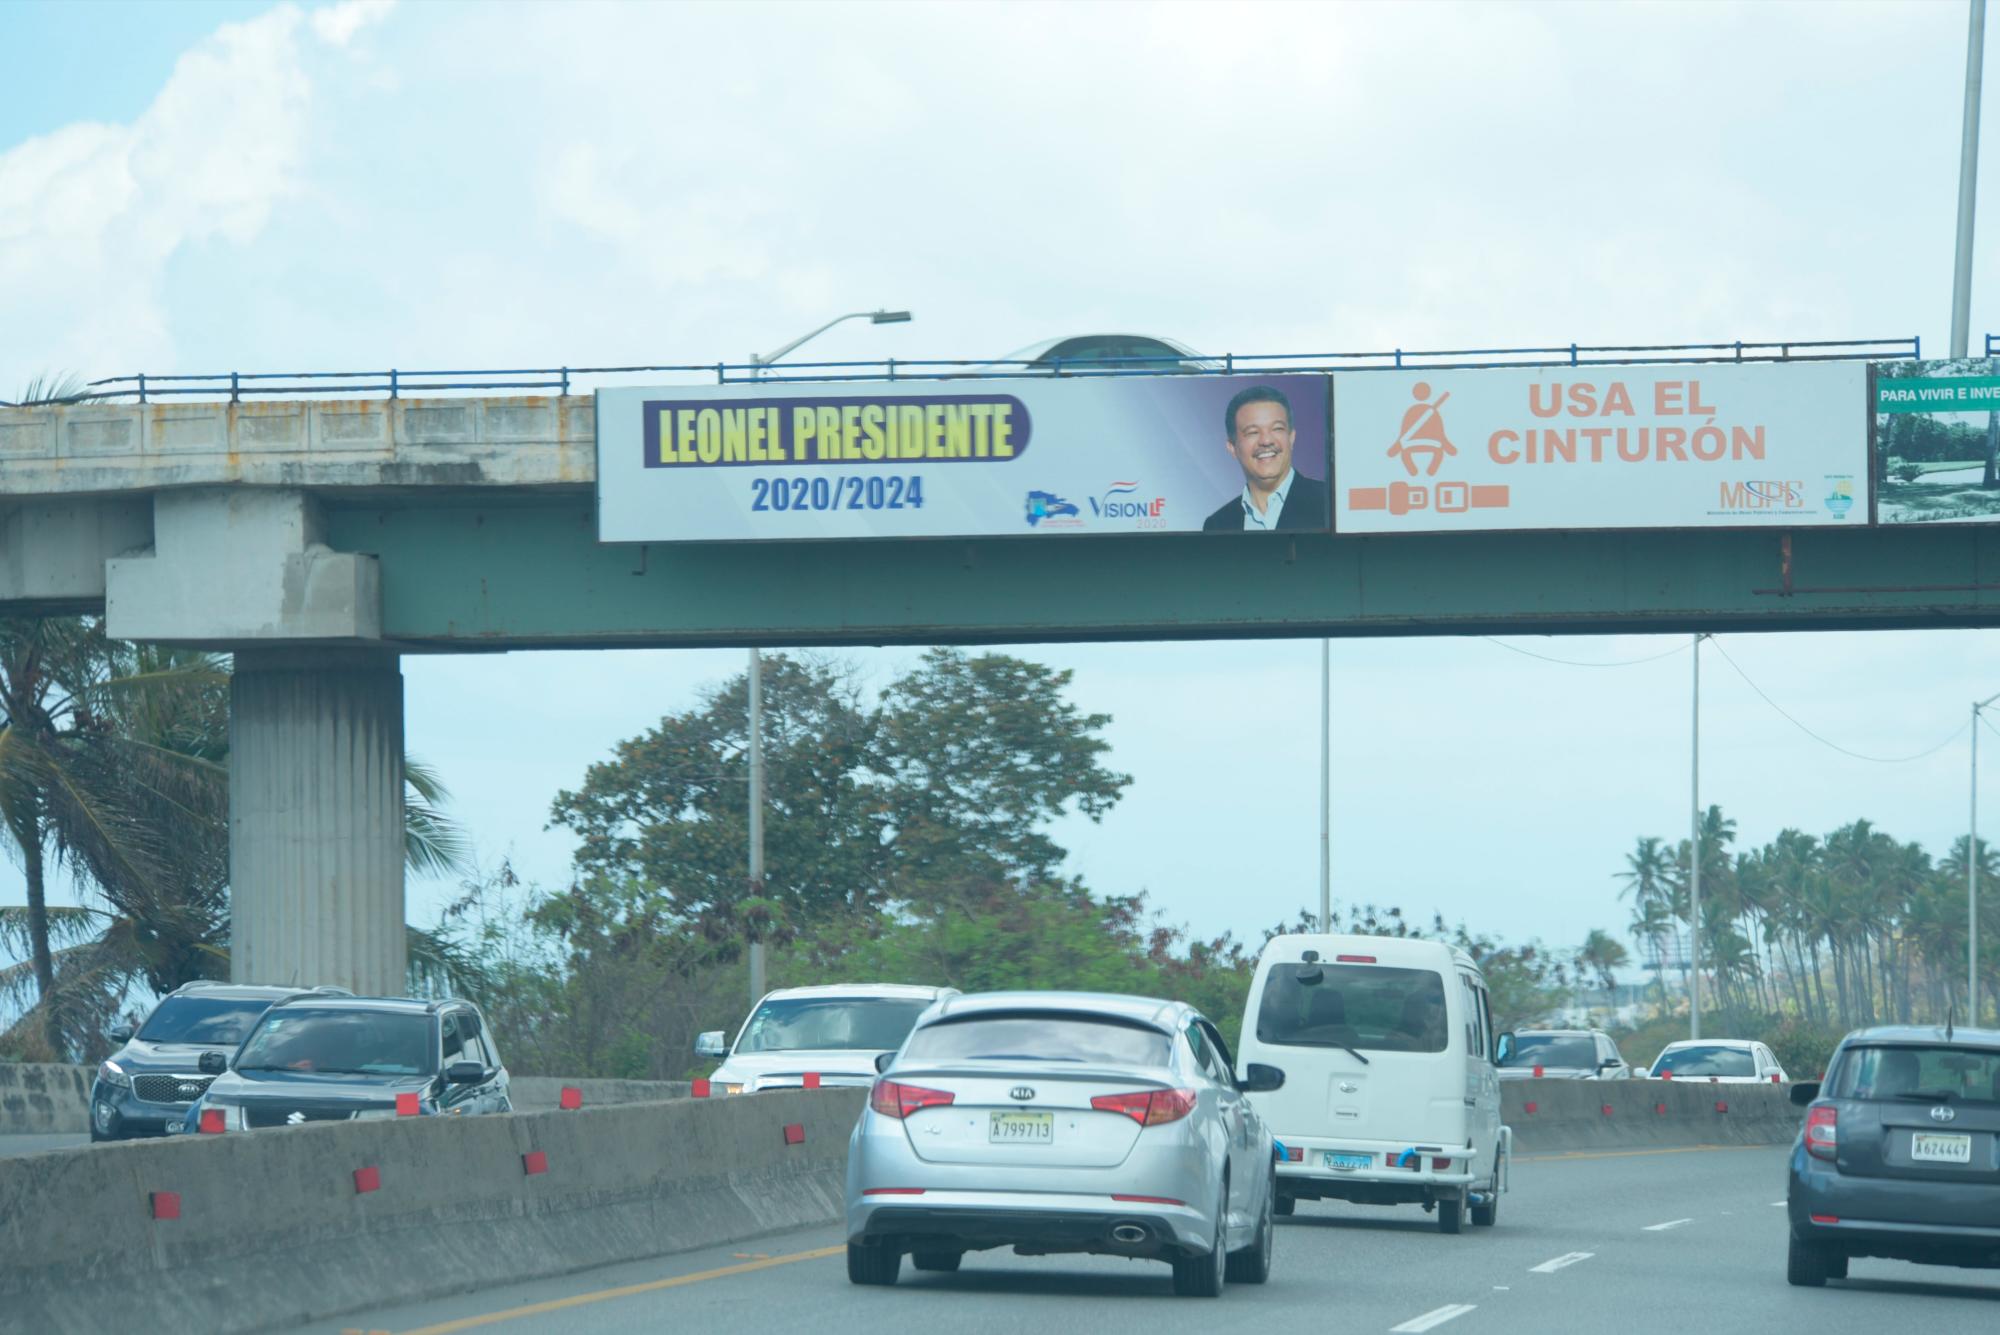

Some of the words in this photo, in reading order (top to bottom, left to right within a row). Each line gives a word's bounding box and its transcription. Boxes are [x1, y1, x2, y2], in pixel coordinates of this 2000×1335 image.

[1528, 381, 1635, 418] USA
[1654, 380, 1716, 416] EL
[1880, 389, 1917, 401] PARA
[1918, 388, 1954, 400] VIVIR
[1957, 388, 1967, 399] E
[659, 407, 785, 463] LEONEL
[793, 403, 1014, 460] PRESIDENTE
[1488, 417, 1766, 464] CINTURÓN
[751, 475, 924, 511] 2020/2024
[1010, 1088, 1035, 1099] KIA
[993, 1121, 1050, 1138] A799713
